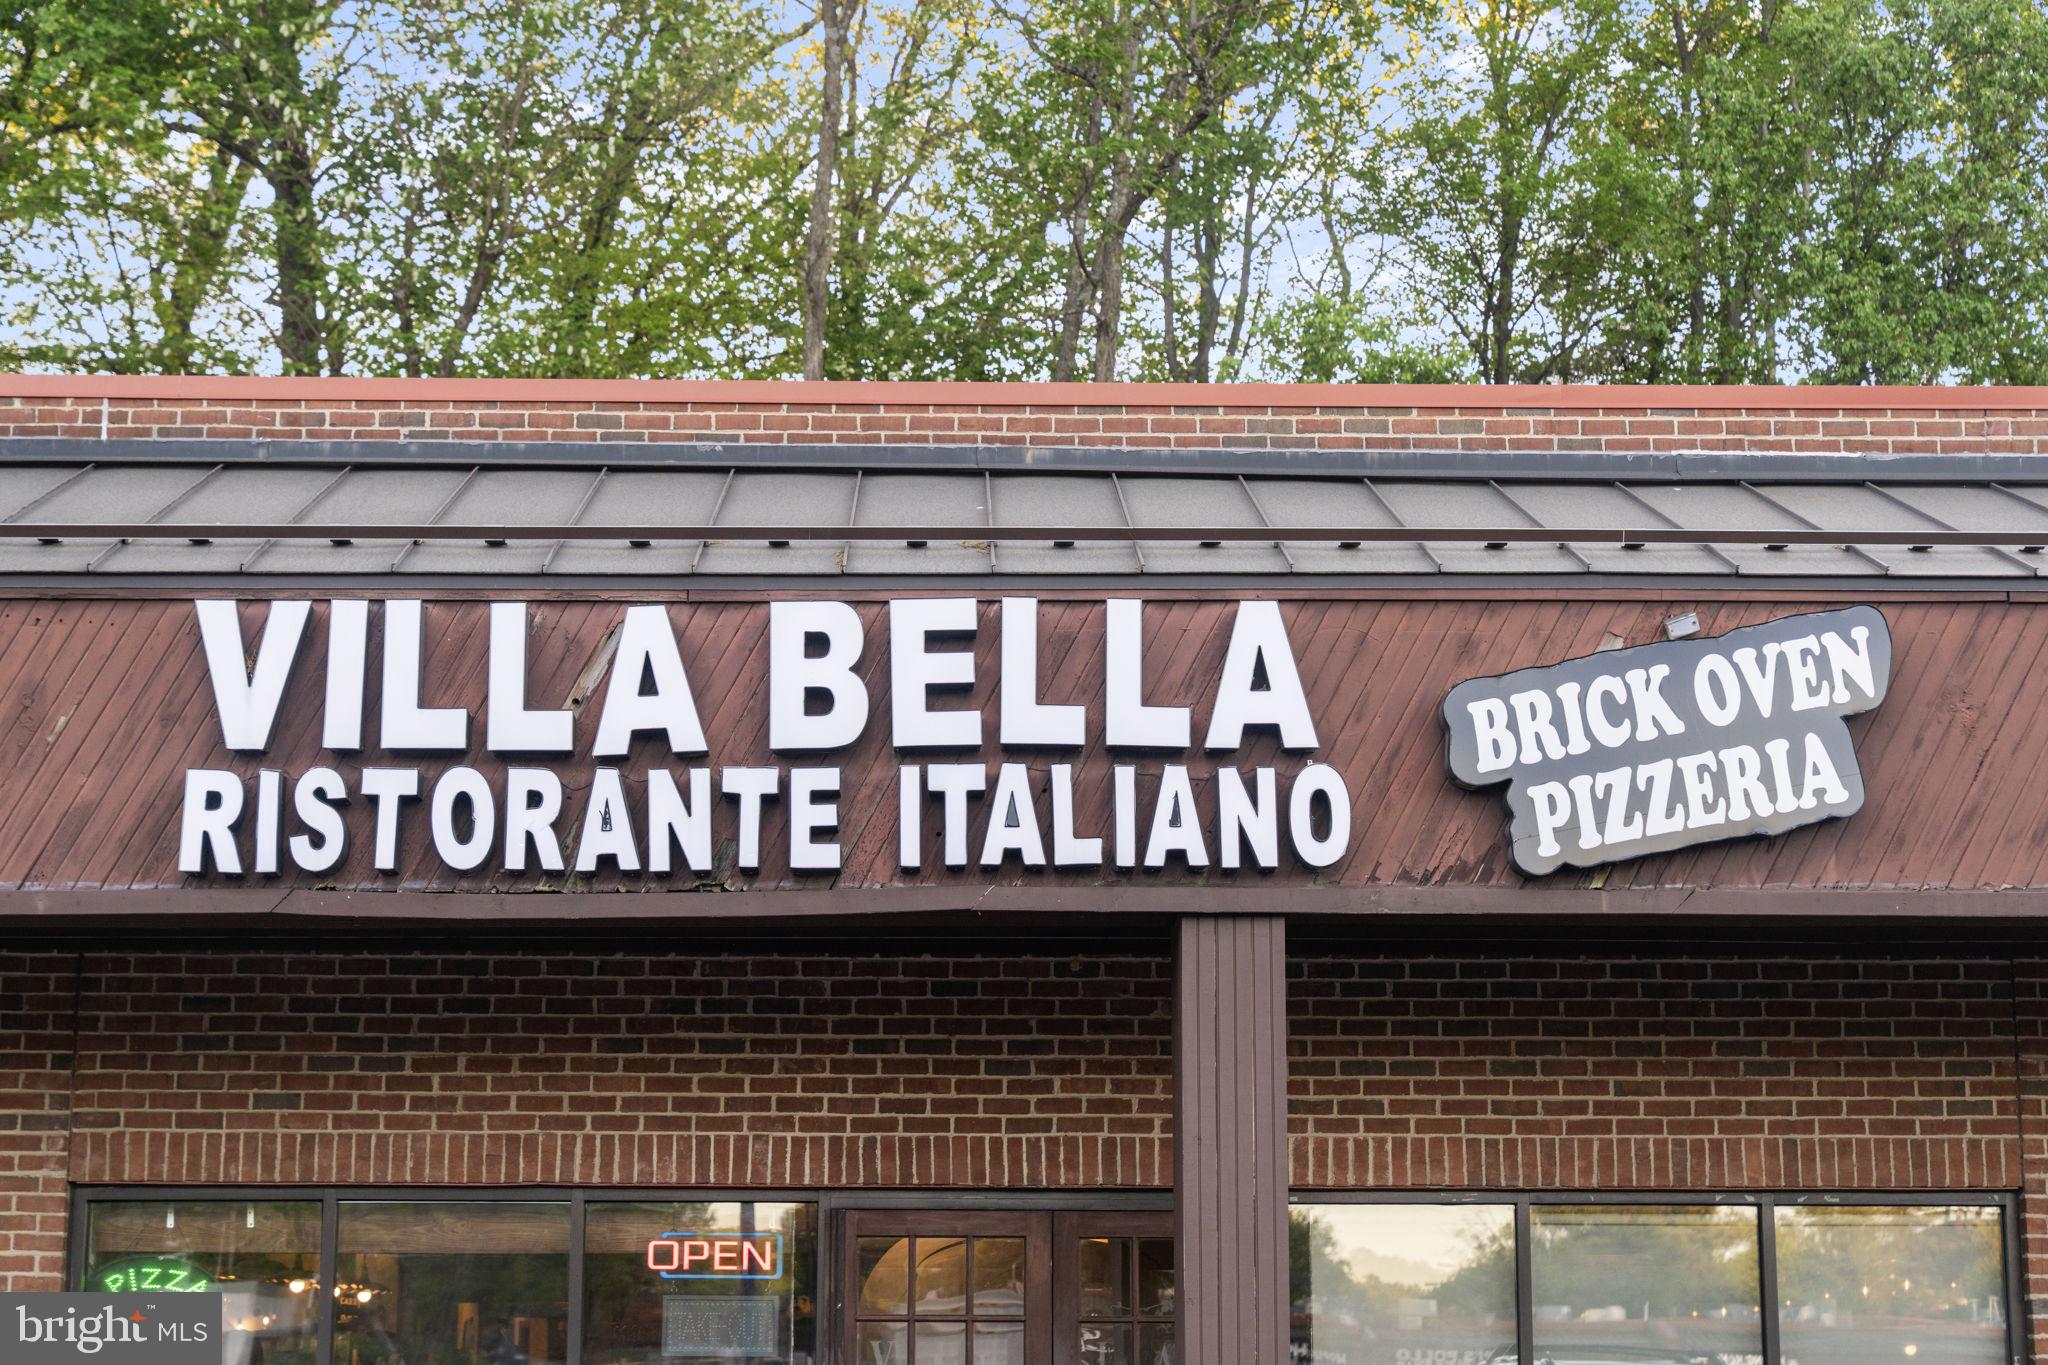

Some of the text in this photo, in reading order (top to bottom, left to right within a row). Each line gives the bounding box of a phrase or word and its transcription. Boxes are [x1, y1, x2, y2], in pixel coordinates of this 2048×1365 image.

[195, 596, 1319, 758] VILLA BELLA
[1467, 626, 1876, 773] BRICK OVEN
[178, 762, 1351, 875] RISTORANTE ITALIANO
[1526, 732, 1849, 858] PIZZERIA
[647, 1240, 772, 1271] OPEN
